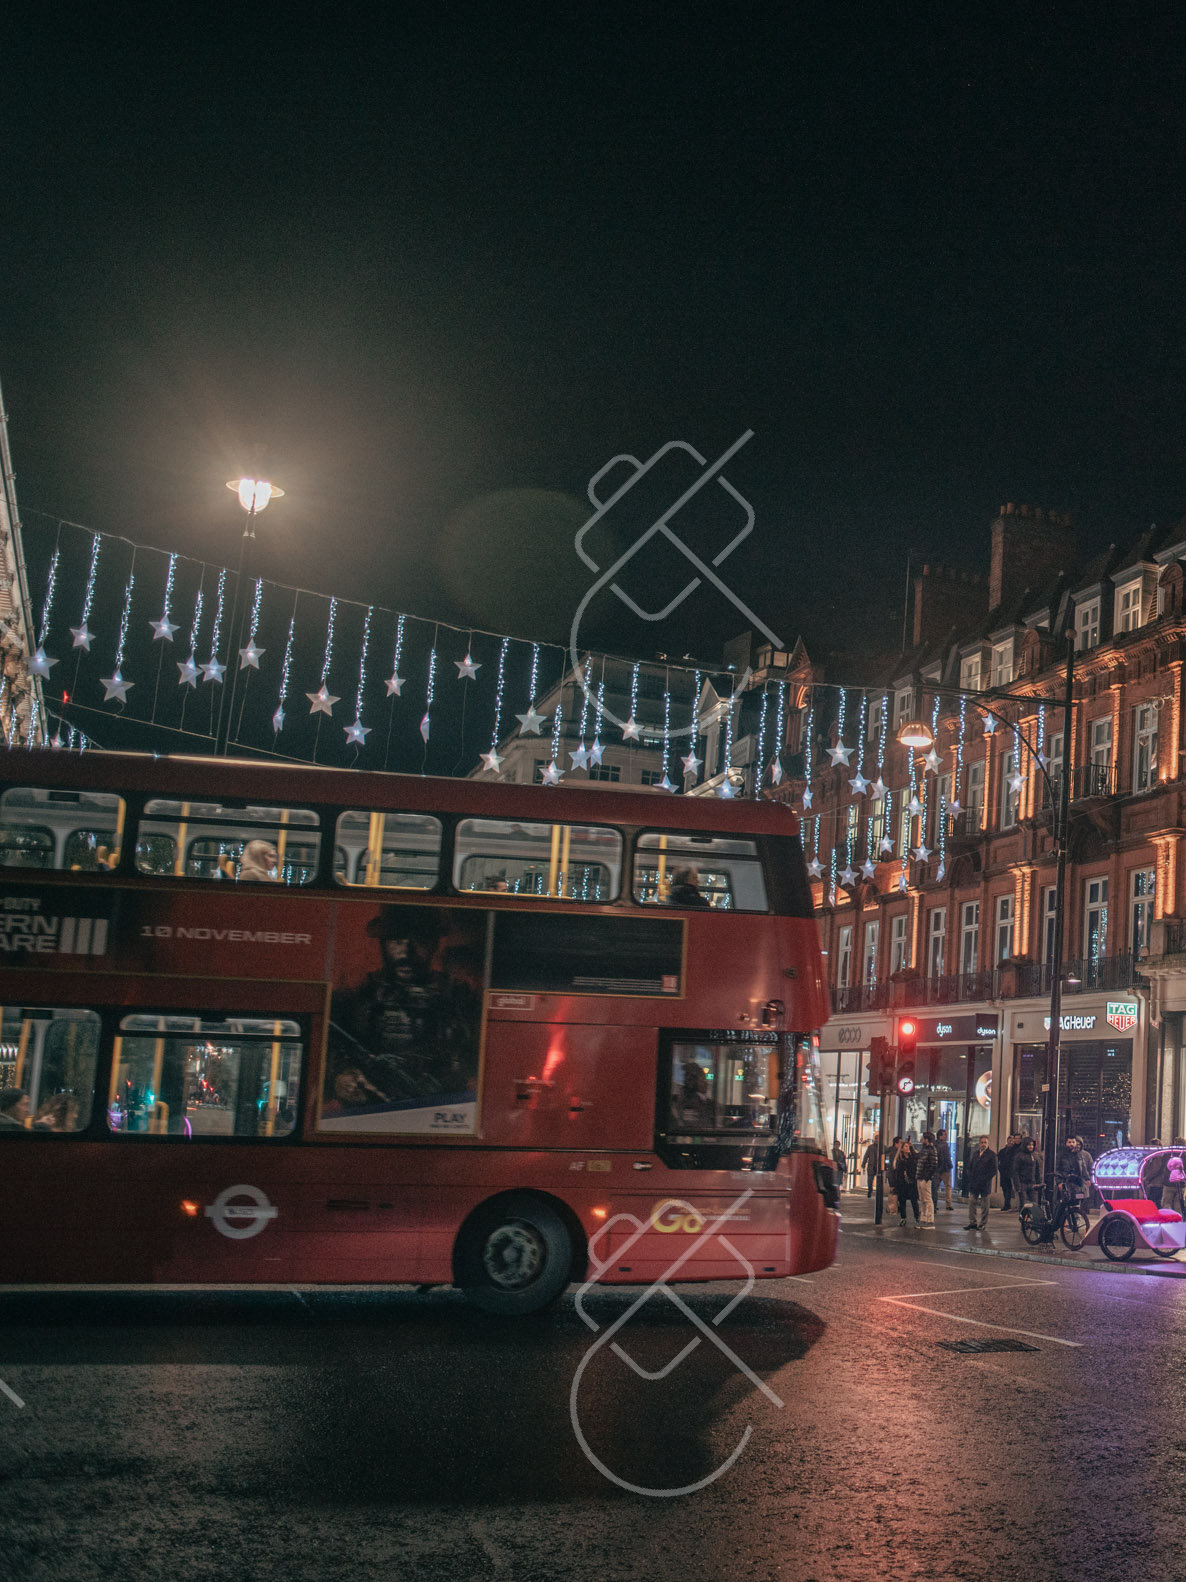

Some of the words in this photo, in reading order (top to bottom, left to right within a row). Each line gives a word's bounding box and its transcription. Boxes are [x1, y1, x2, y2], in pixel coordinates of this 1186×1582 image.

[140, 925, 171, 938] 10
[176, 926, 311, 945] NOVEMBER
[1109, 1004, 1135, 1015] TAG
[936, 1022, 953, 1038] dyson
[1108, 1014, 1136, 1030] HEUER
[977, 1026, 997, 1037] dyson
